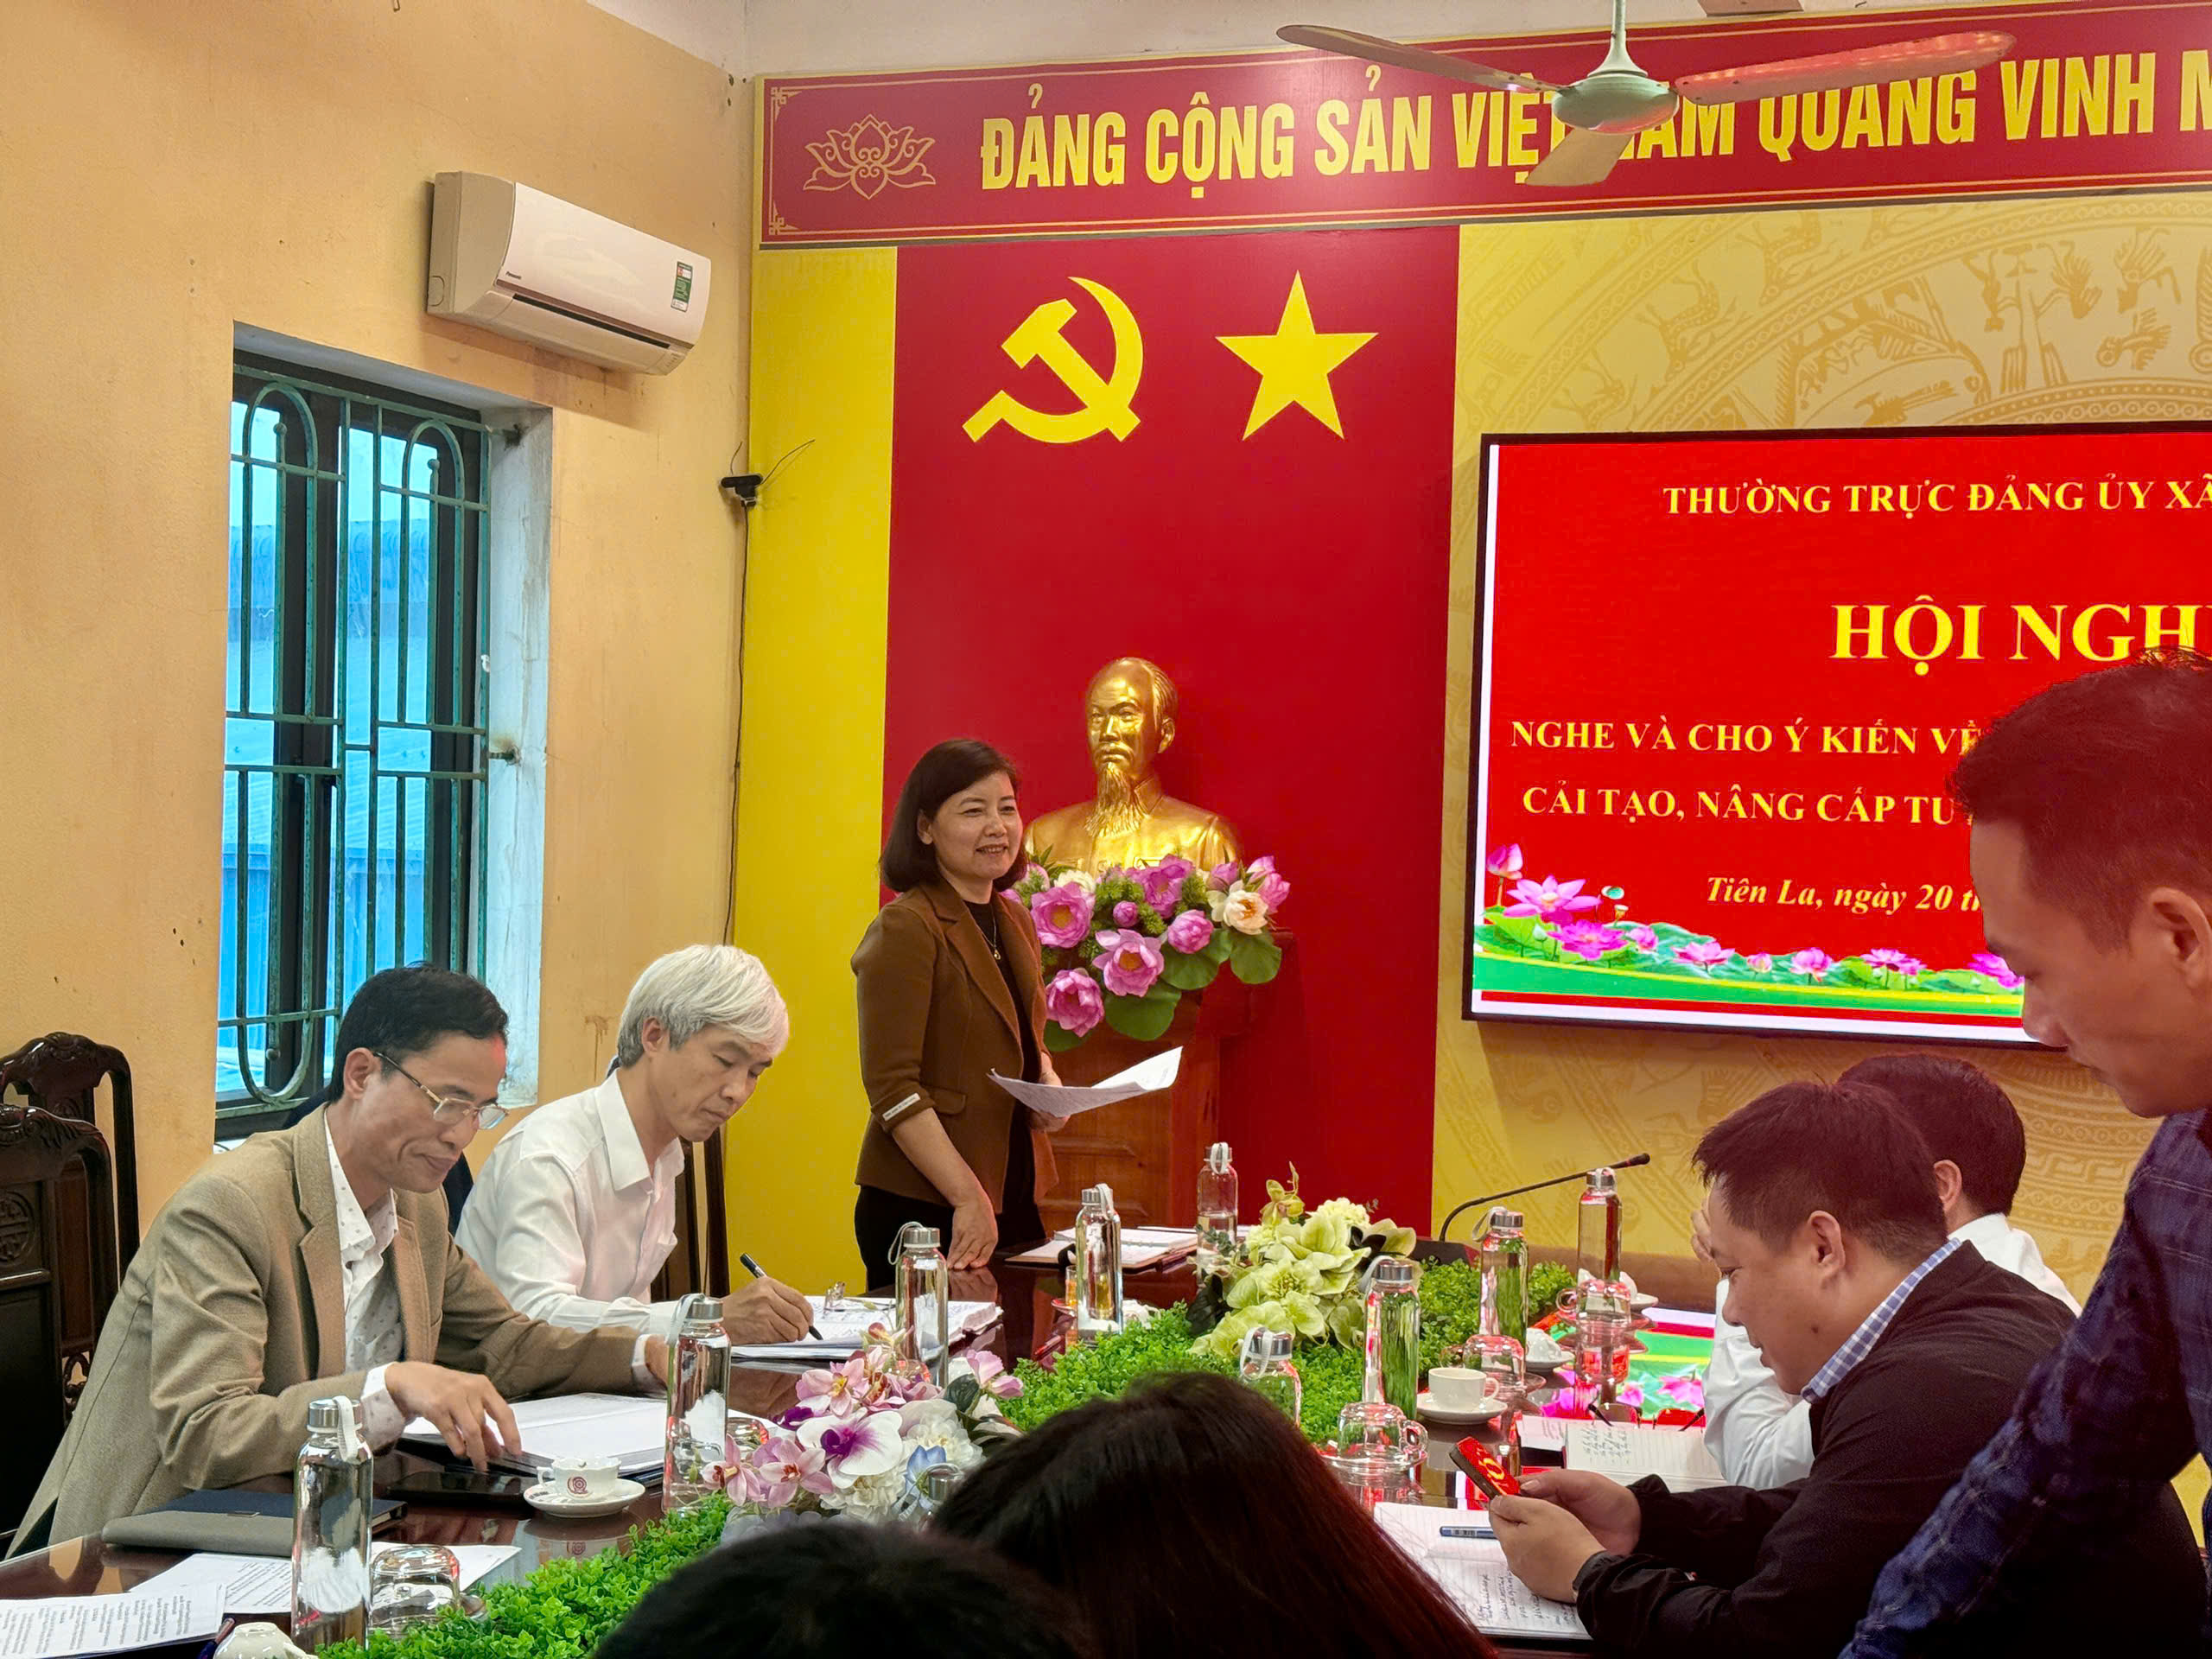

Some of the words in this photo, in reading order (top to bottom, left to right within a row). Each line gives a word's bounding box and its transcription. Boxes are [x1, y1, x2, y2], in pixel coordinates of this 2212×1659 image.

[981, 84, 1126, 190] ĐẢNG
[1146, 92, 1294, 199] CỘNG
[1315, 66, 1432, 175] SẢN
[1452, 73, 1567, 184] VIỆ
[1758, 70, 1977, 162] QUANG
[2001, 54, 2156, 140] VINH
[1663, 479, 1831, 514] THƯỜNG
[1844, 480, 1955, 519] TRỰC
[1967, 475, 2084, 512] ĐẢNG
[2100, 474, 2154, 510] ỦY
[1832, 594, 1985, 677] HỘI
[2009, 603, 2212, 664] NGH
[1512, 721, 1615, 749] NGHE
[1626, 715, 1676, 750] VÀ
[1688, 724, 1773, 753] CHO
[1785, 717, 1809, 753] Ý
[1822, 719, 1917, 754] KIẾN
[1523, 781, 1586, 815] CẢI
[1598, 790, 1685, 823] TẠO,
[1698, 784, 1805, 821] NÂNG
[1817, 787, 1896, 823] CẤP
[1708, 878, 1767, 904] Tiên
[1777, 880, 1823, 908] La,
[1834, 883, 1907, 916] ngày
[1916, 885, 1954, 911] 20
